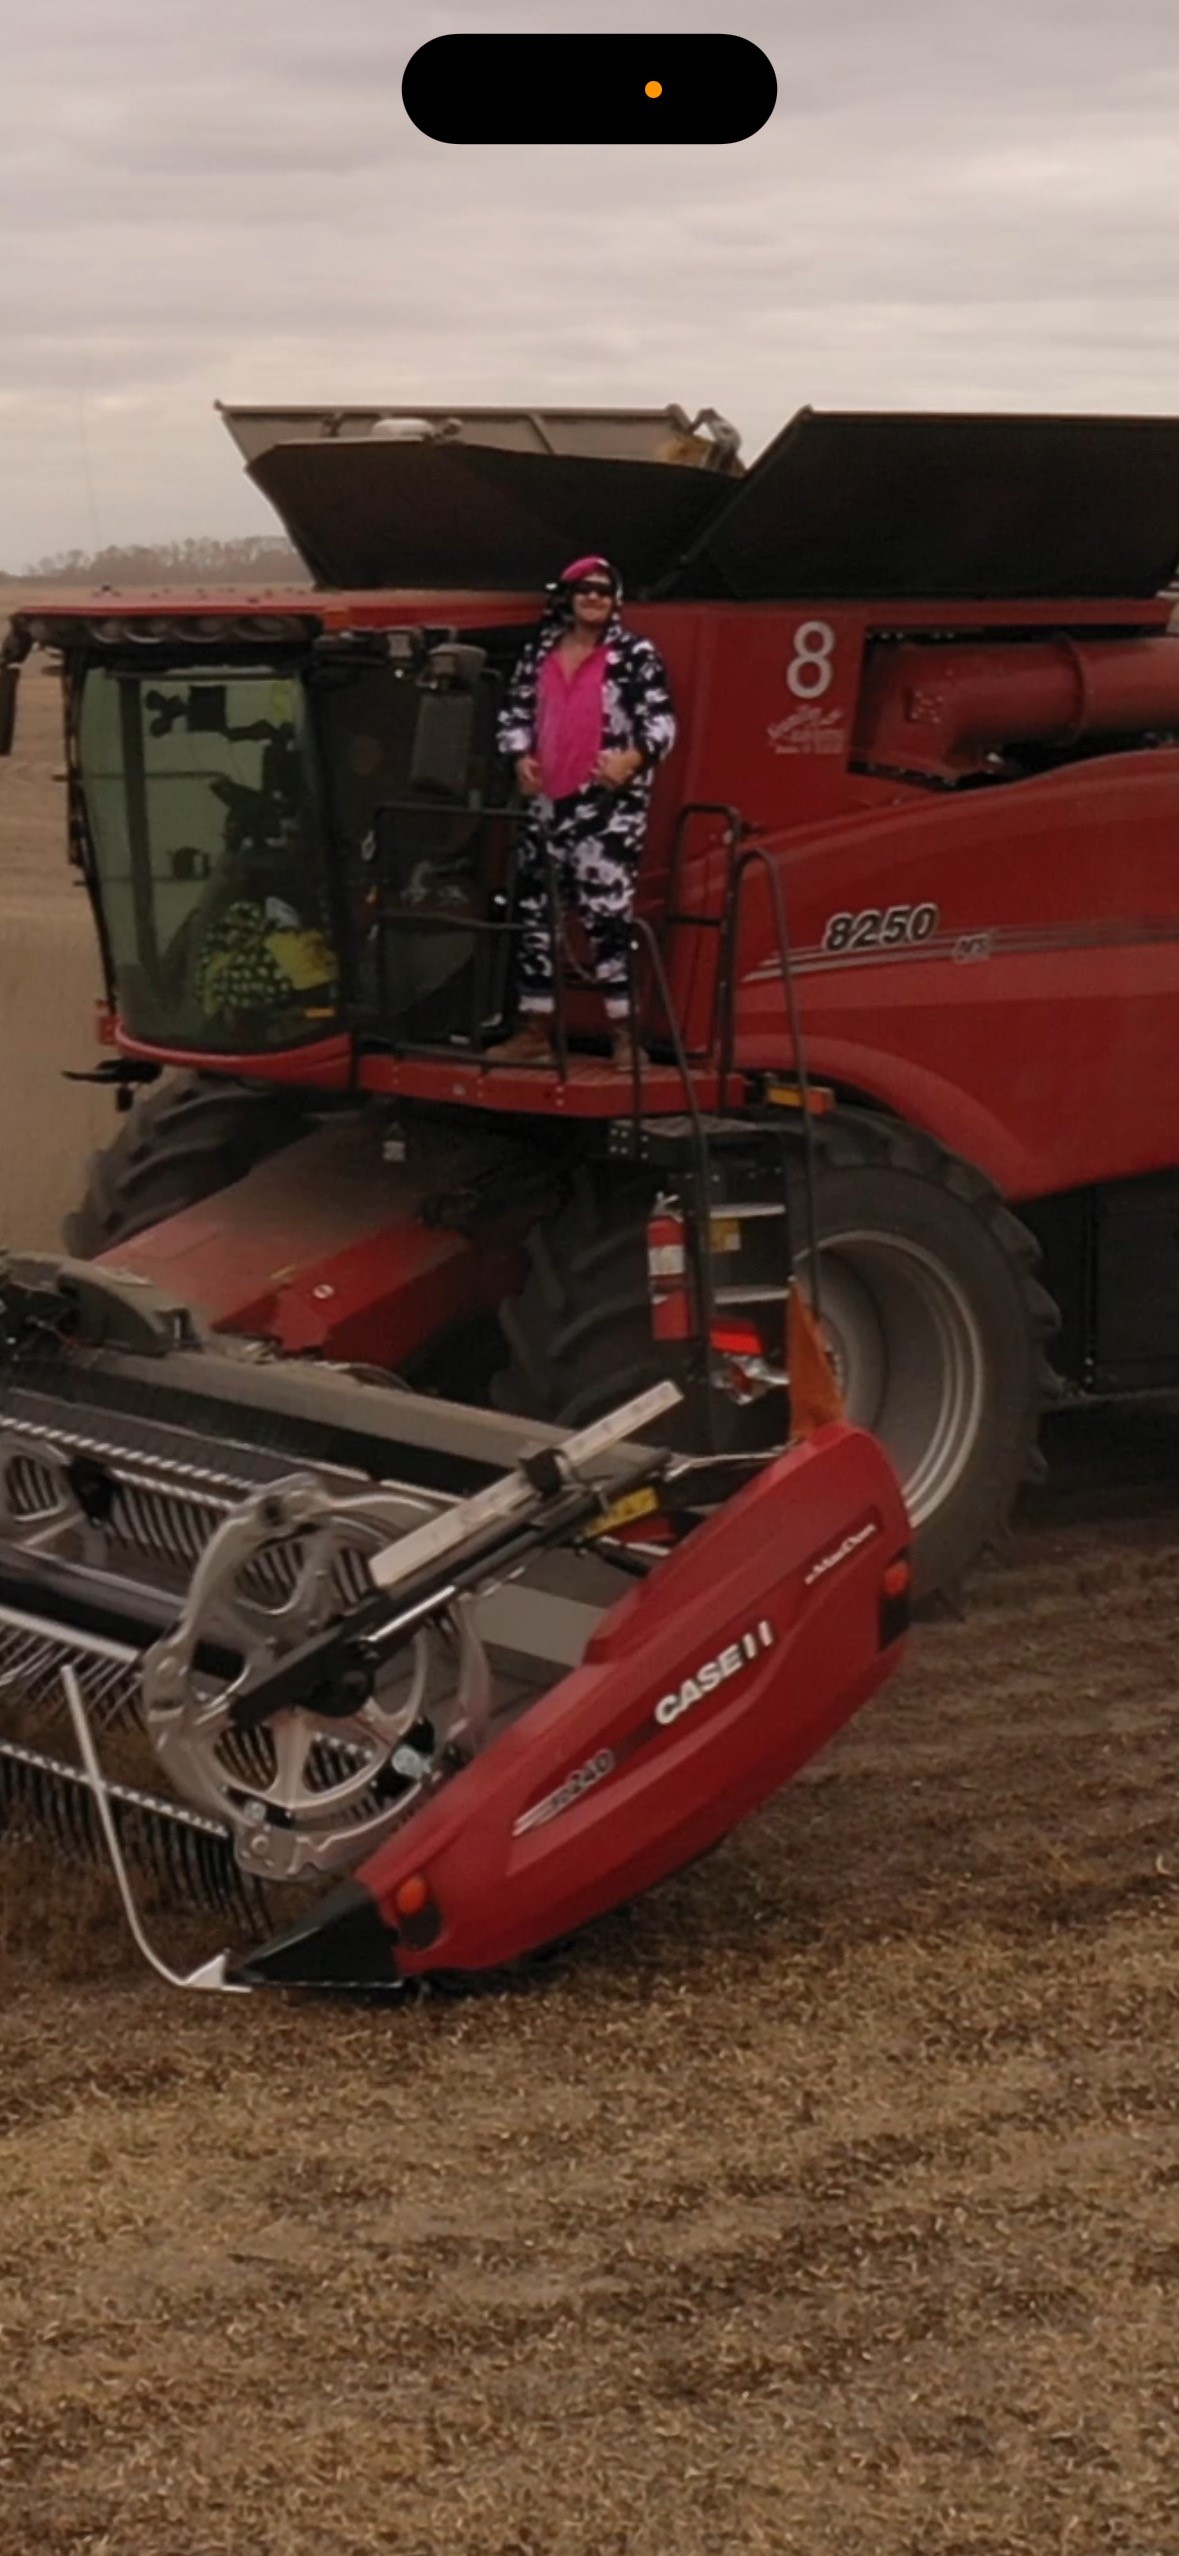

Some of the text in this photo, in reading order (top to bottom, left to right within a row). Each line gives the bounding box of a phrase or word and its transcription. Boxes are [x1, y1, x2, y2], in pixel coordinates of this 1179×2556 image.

[786, 620, 835, 699] 8
[822, 902, 939, 953] 8250
[655, 1643, 743, 1725] CASE
